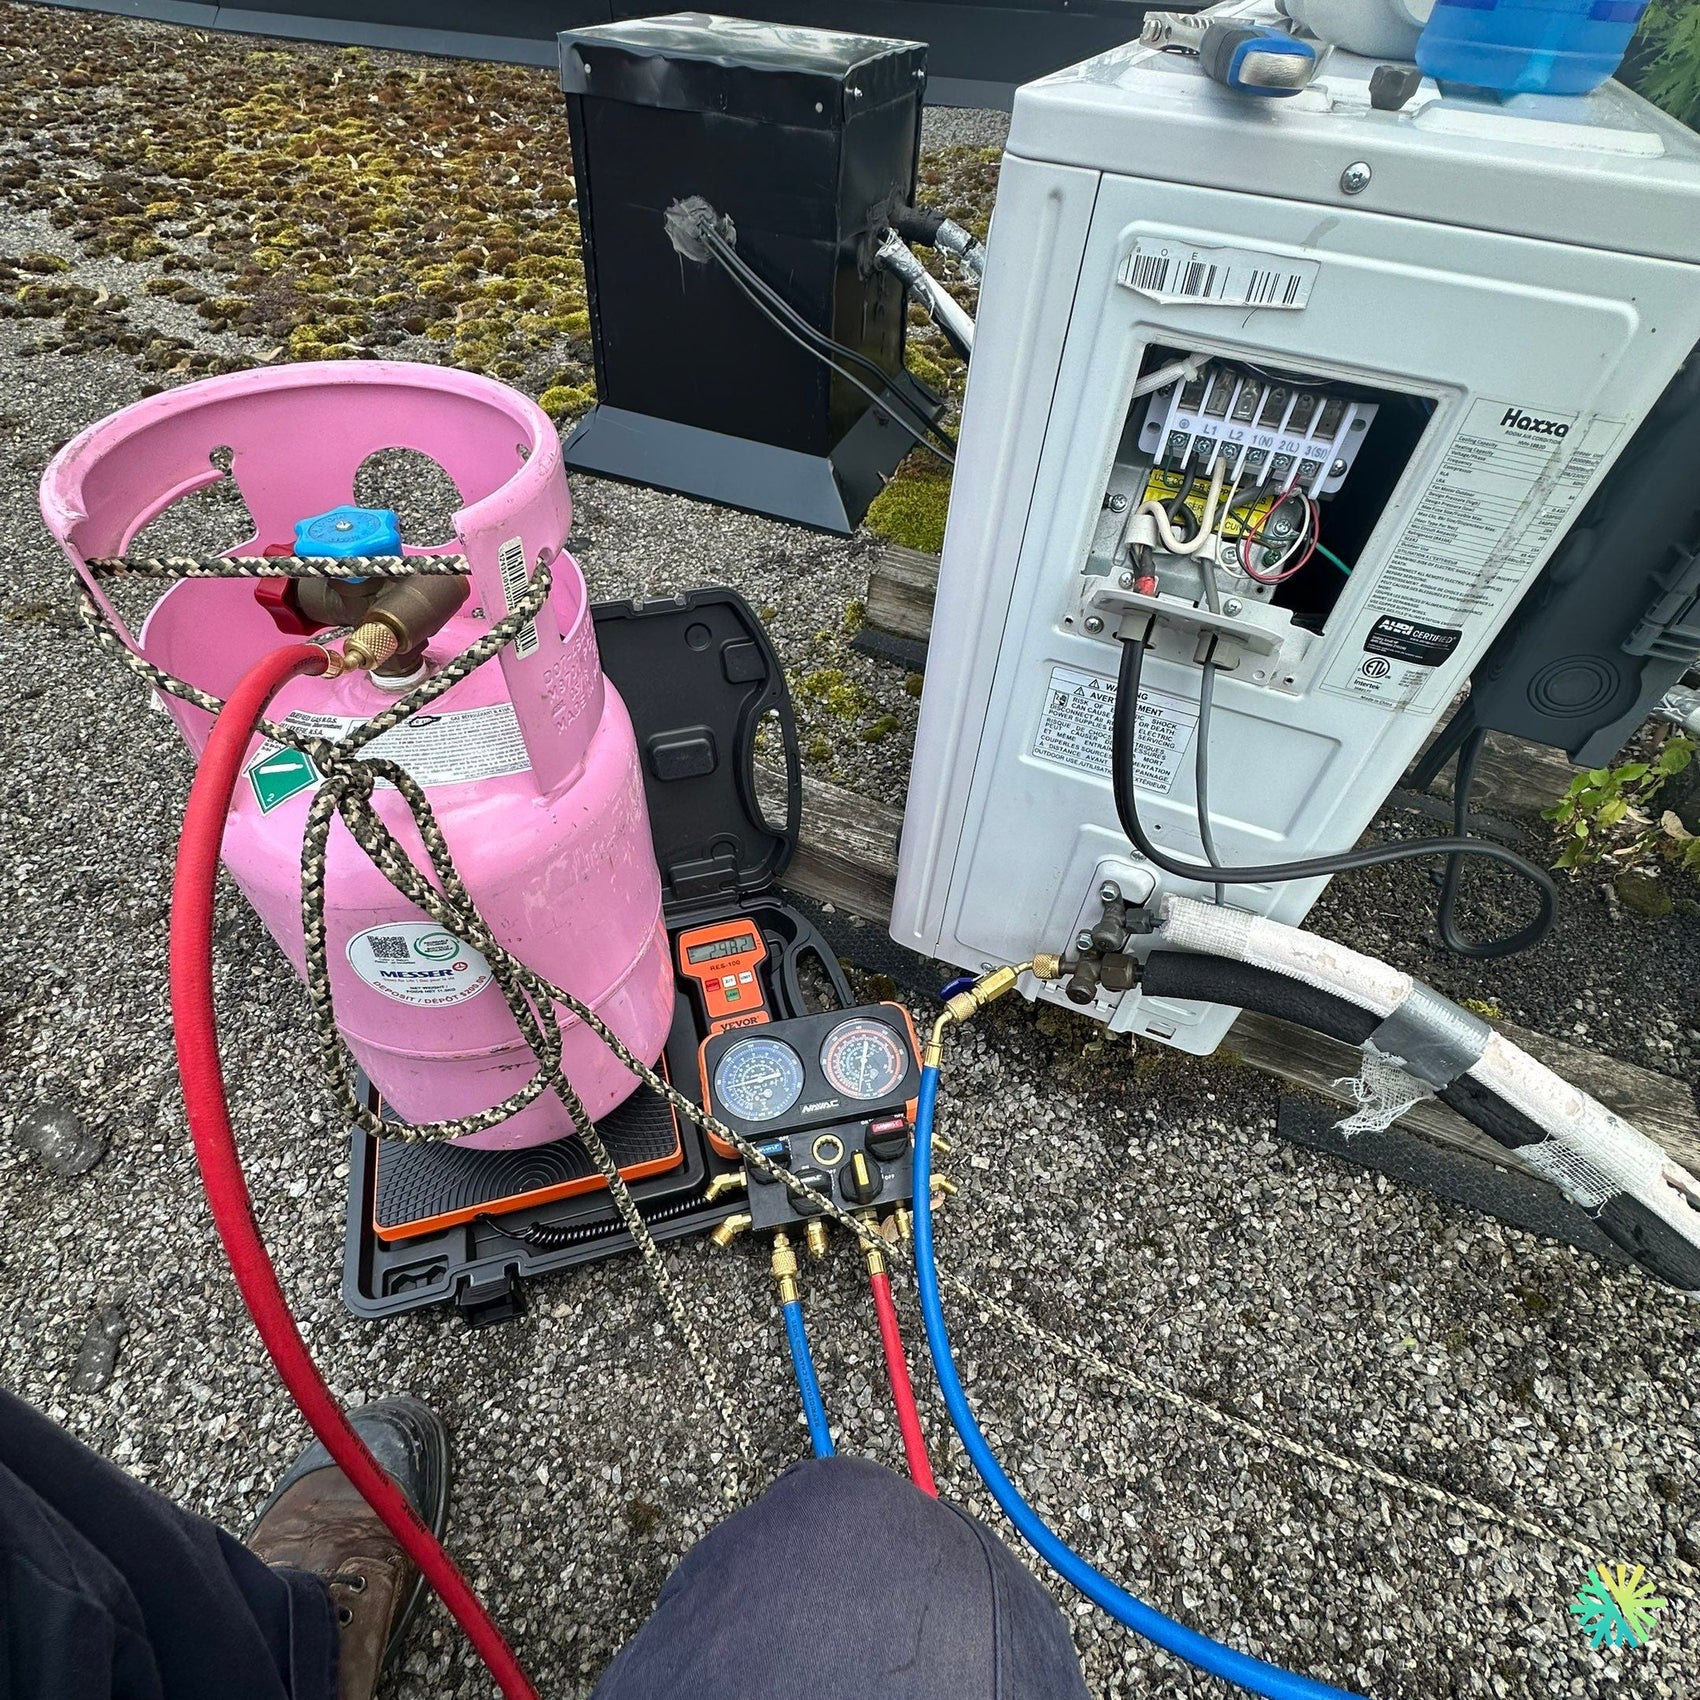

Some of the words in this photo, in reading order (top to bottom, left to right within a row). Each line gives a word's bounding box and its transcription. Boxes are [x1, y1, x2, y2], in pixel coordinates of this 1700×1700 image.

[1500, 408, 1568, 437] Haxxa
[1203, 423, 1217, 434] L1
[1229, 429, 1244, 441] L2
[1252, 434, 1273, 448] 1(N)
[1278, 440, 1300, 453] 2(L)
[1412, 630, 1452, 643] CERTIFIED
[1353, 678, 1379, 690] Intertek
[1072, 696, 1088, 705] RISK
[1070, 702, 1086, 711] CAN
[1086, 707, 1110, 718] CAUSE
[1046, 717, 1070, 728] RISQUE
[1048, 709, 1073, 720] POWER
[1074, 716, 1106, 729] SUPPLIES
[1049, 702, 1093, 719] DISCONNECT
[1138, 728, 1172, 742] ELECTRIC
[1044, 721, 1062, 730] PEUT
[1070, 729, 1098, 741] CAUSER
[1034, 747, 1064, 760] OUTDOOR
[1048, 743, 1080, 756] DISTANCE
[1085, 754, 1107, 764] AVANT
[267, 793, 274, 802] 2
[710, 960, 740, 971] RES-100
[380, 968, 454, 978] MESSER
[373, 981, 415, 1002] DEPOSIT
[424, 995, 459, 1004] DÉPÔT
[720, 1017, 758, 1032] VEVOR
[801, 1100, 840, 1114] NAVAC
